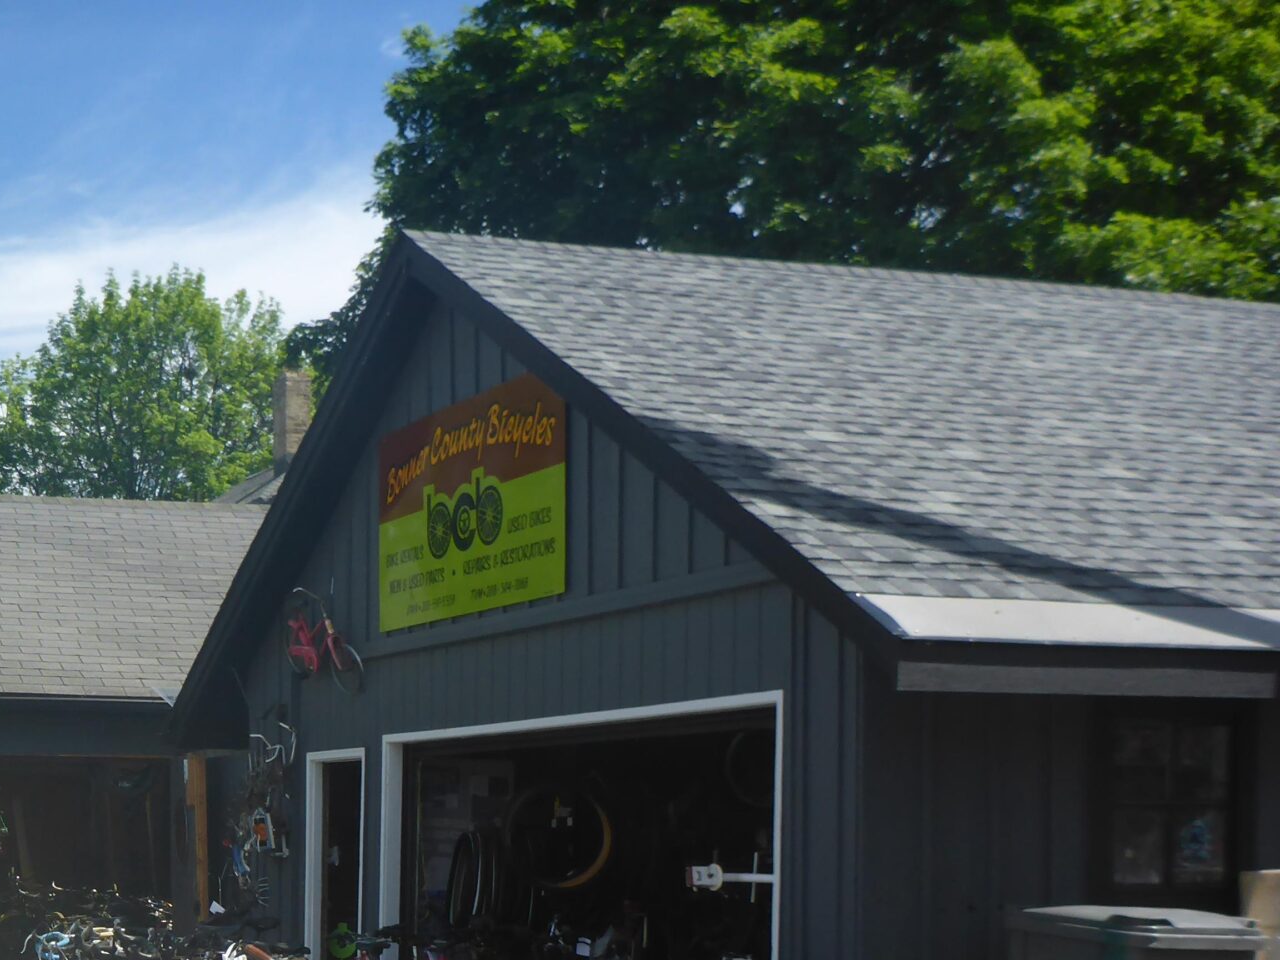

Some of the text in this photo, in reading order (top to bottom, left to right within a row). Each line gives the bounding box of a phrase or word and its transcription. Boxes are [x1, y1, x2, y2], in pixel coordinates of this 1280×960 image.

[386, 402, 557, 504] Bonner County Bicycles
